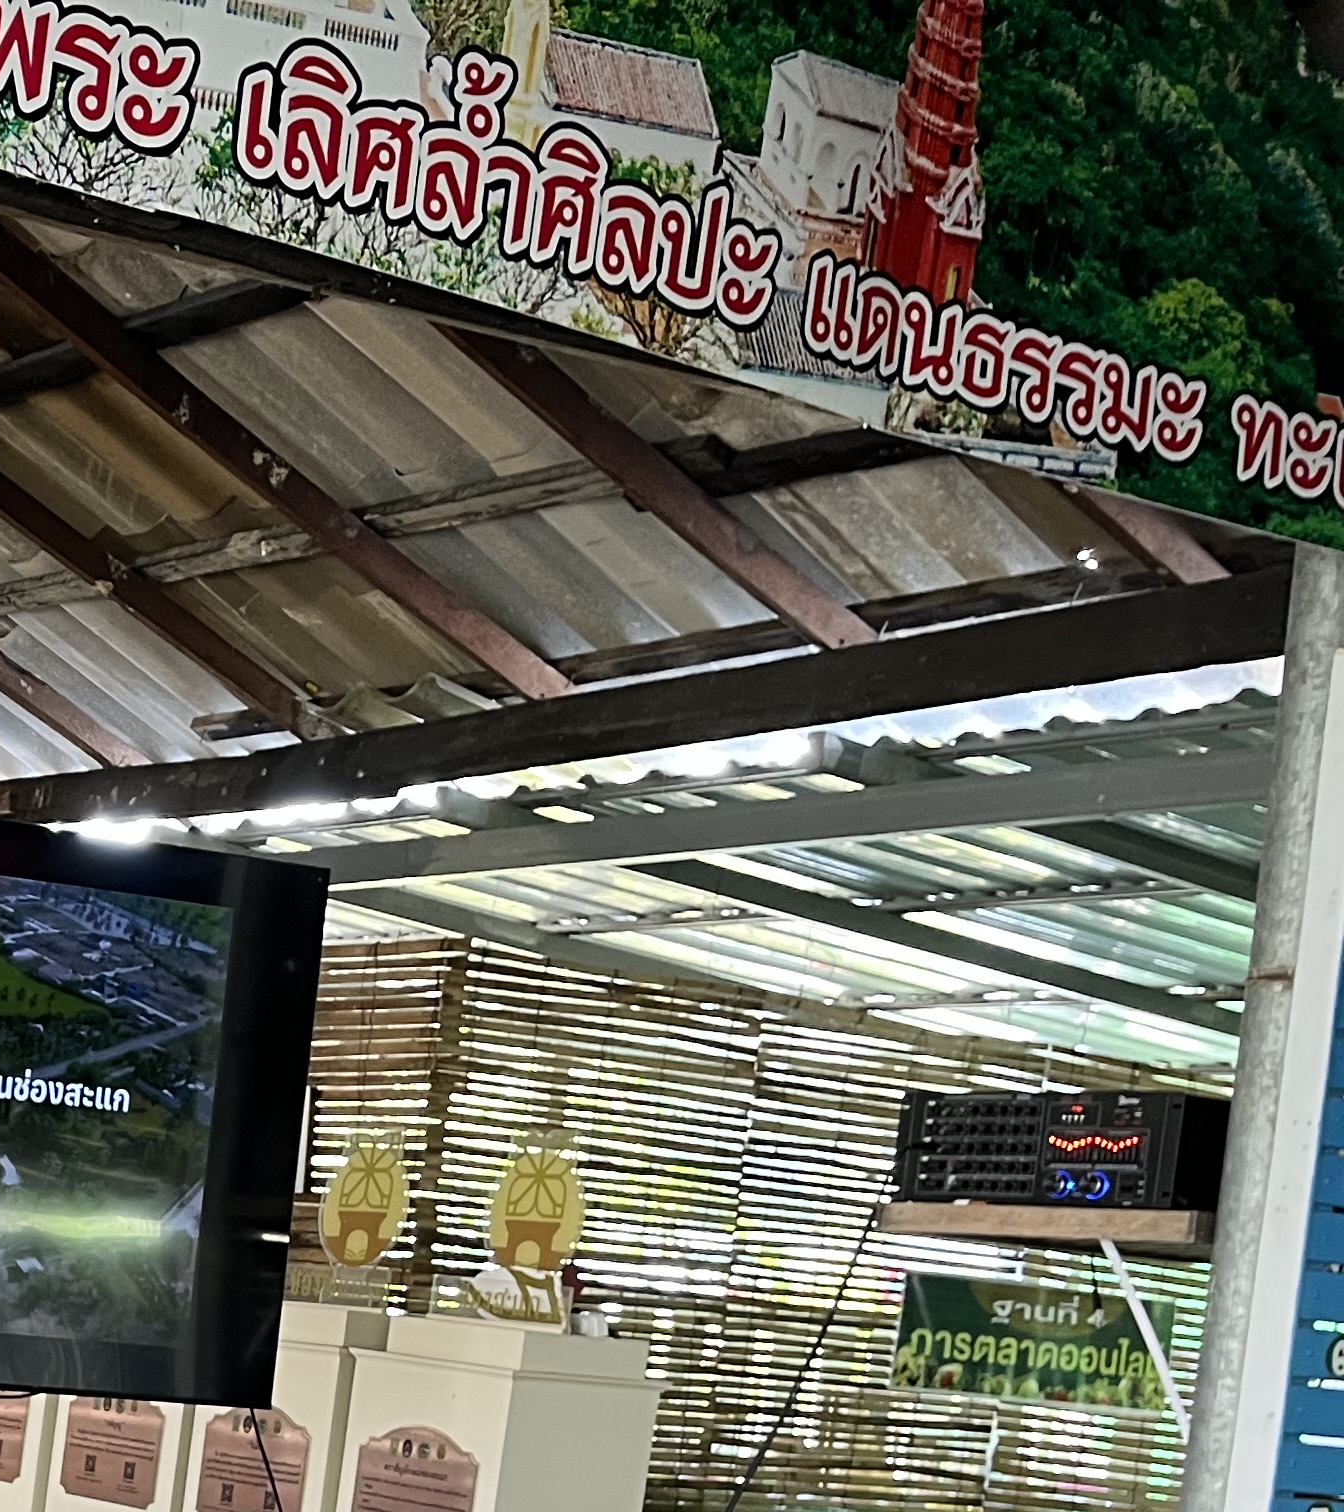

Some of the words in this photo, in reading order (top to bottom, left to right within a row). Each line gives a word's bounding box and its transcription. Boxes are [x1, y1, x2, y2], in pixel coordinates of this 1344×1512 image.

[238, 42, 778, 326] เลิศล้ำศิลปะ
[807, 252, 1206, 462] แดนธรรมะ
[1231, 394, 1344, 509] ทะ
[991, 1296, 1080, 1325] ฐานที่
